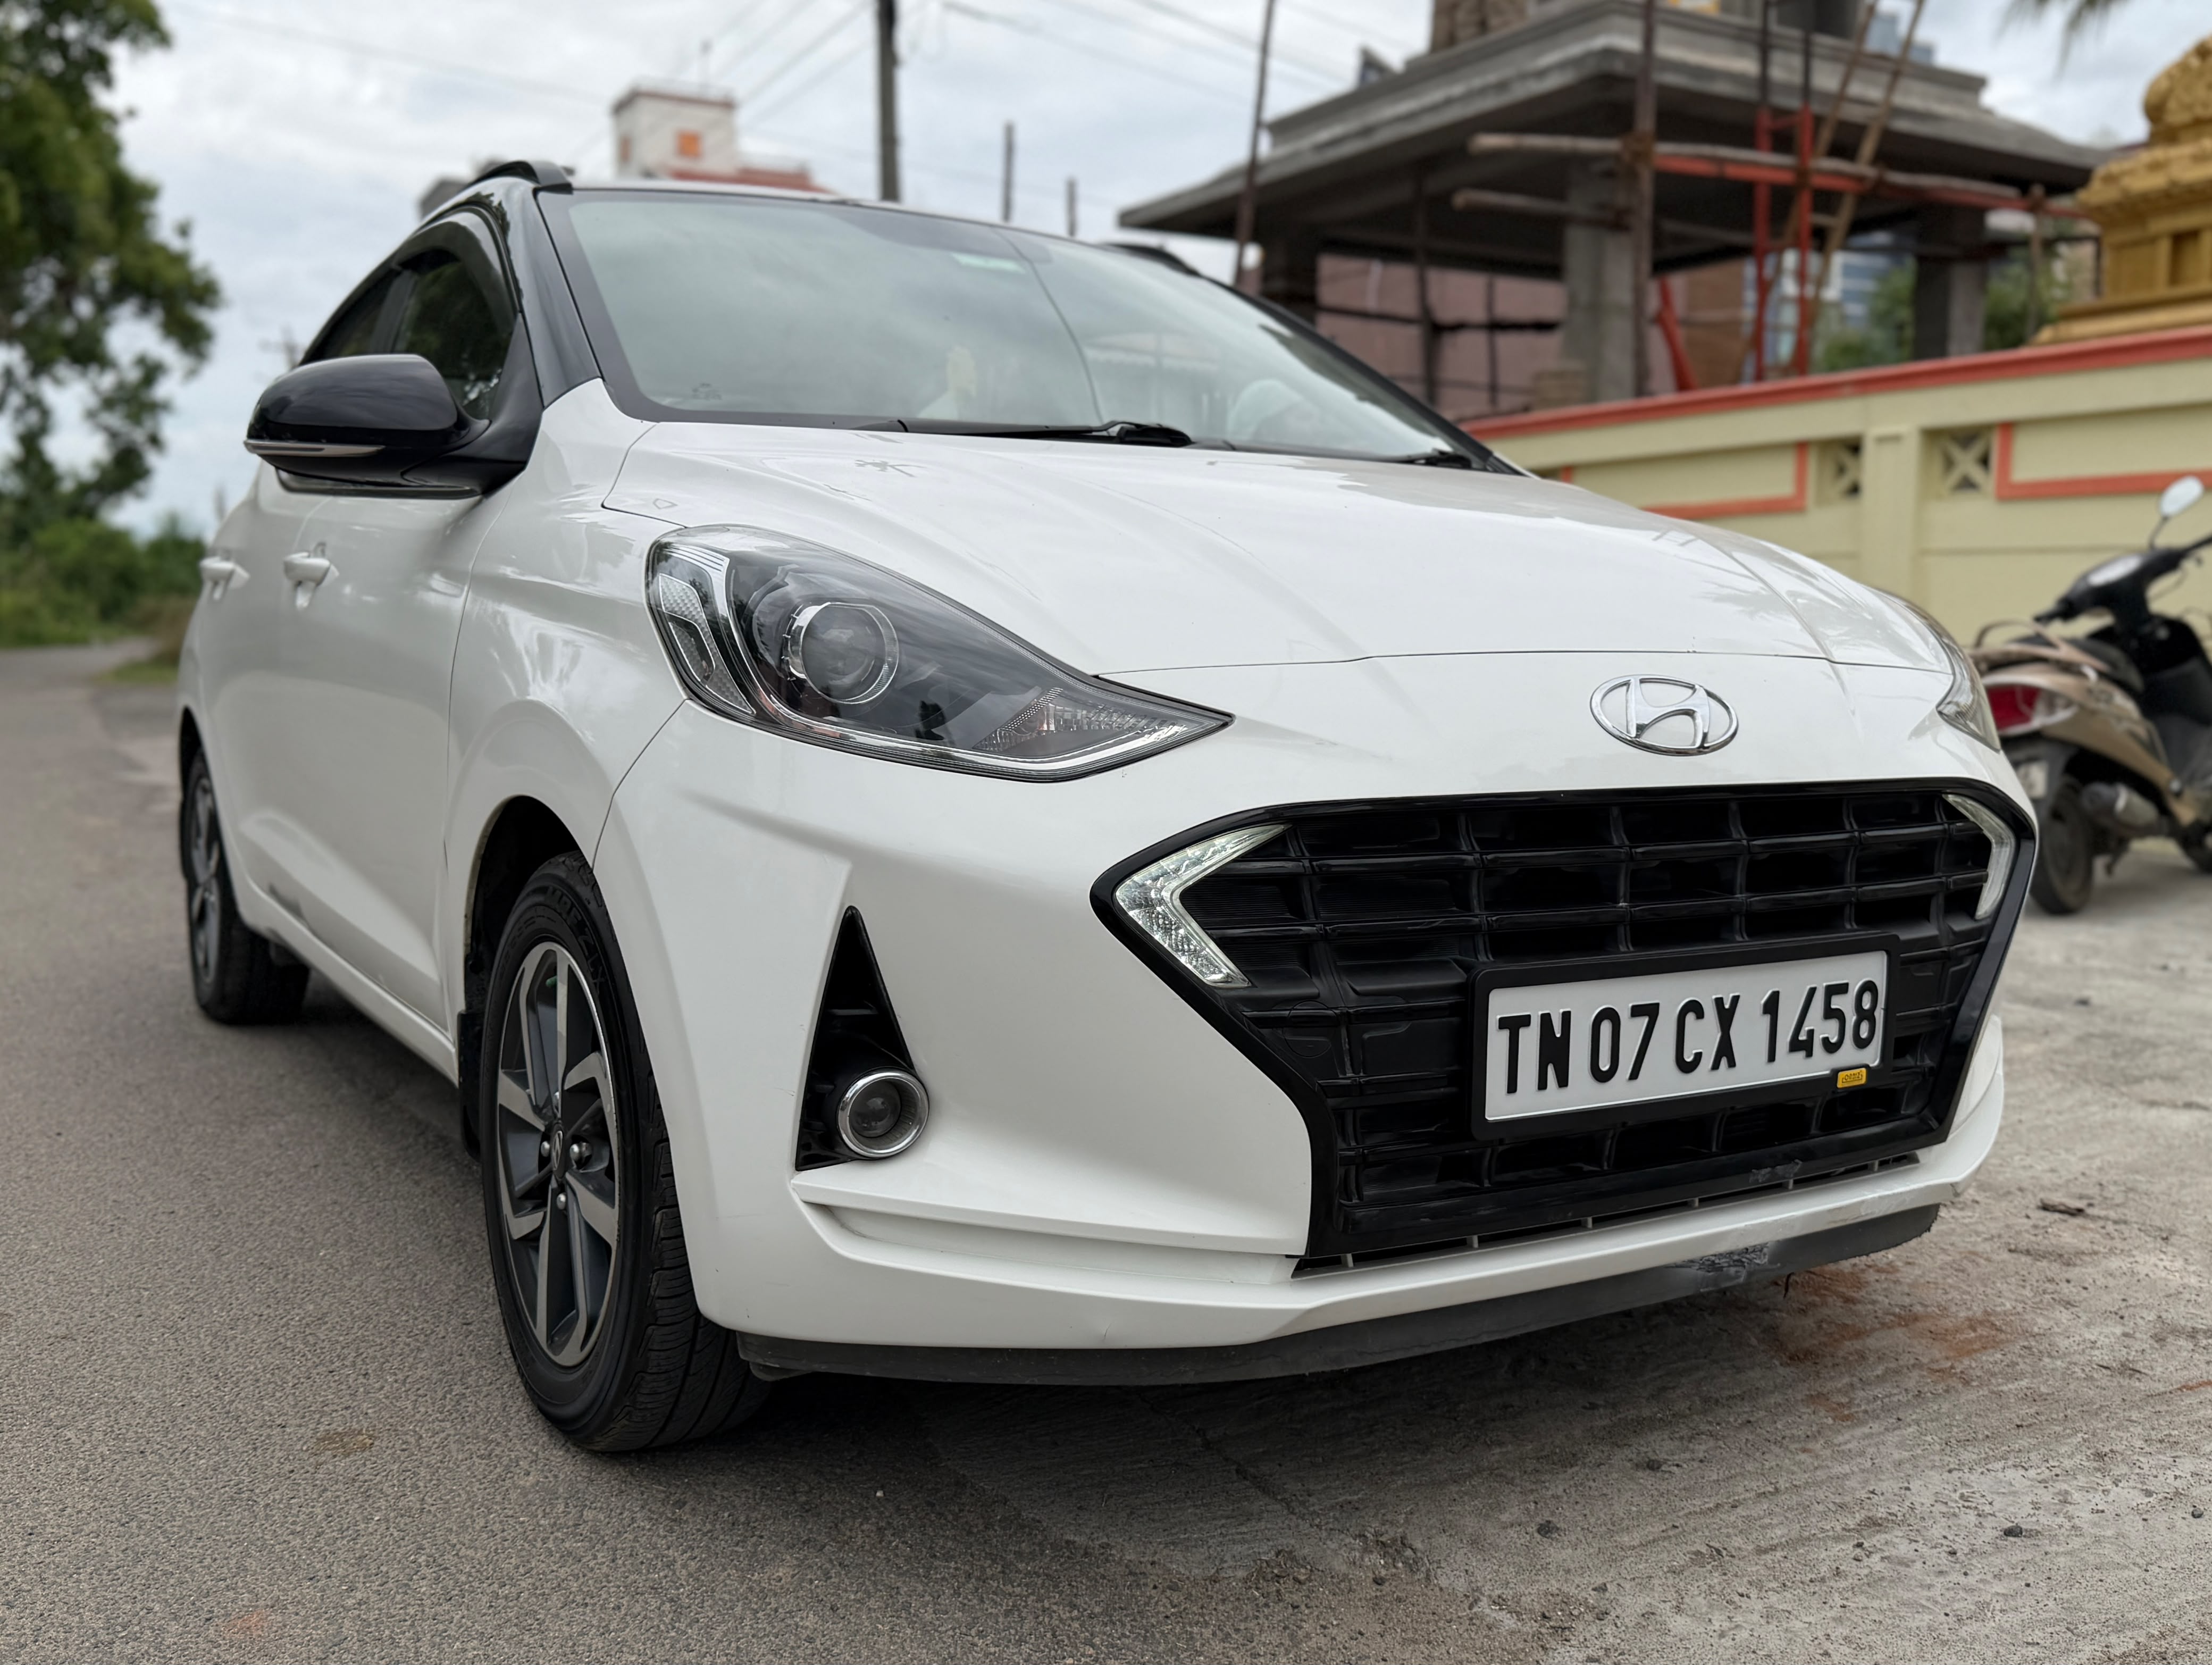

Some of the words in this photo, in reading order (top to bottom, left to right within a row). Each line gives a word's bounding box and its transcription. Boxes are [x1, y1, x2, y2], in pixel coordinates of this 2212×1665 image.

[1497, 1010, 1572, 1094] TN
[1589, 1002, 1661, 1084] 07
[1675, 994, 1741, 1074] CX
[1762, 980, 1879, 1064] 1458
